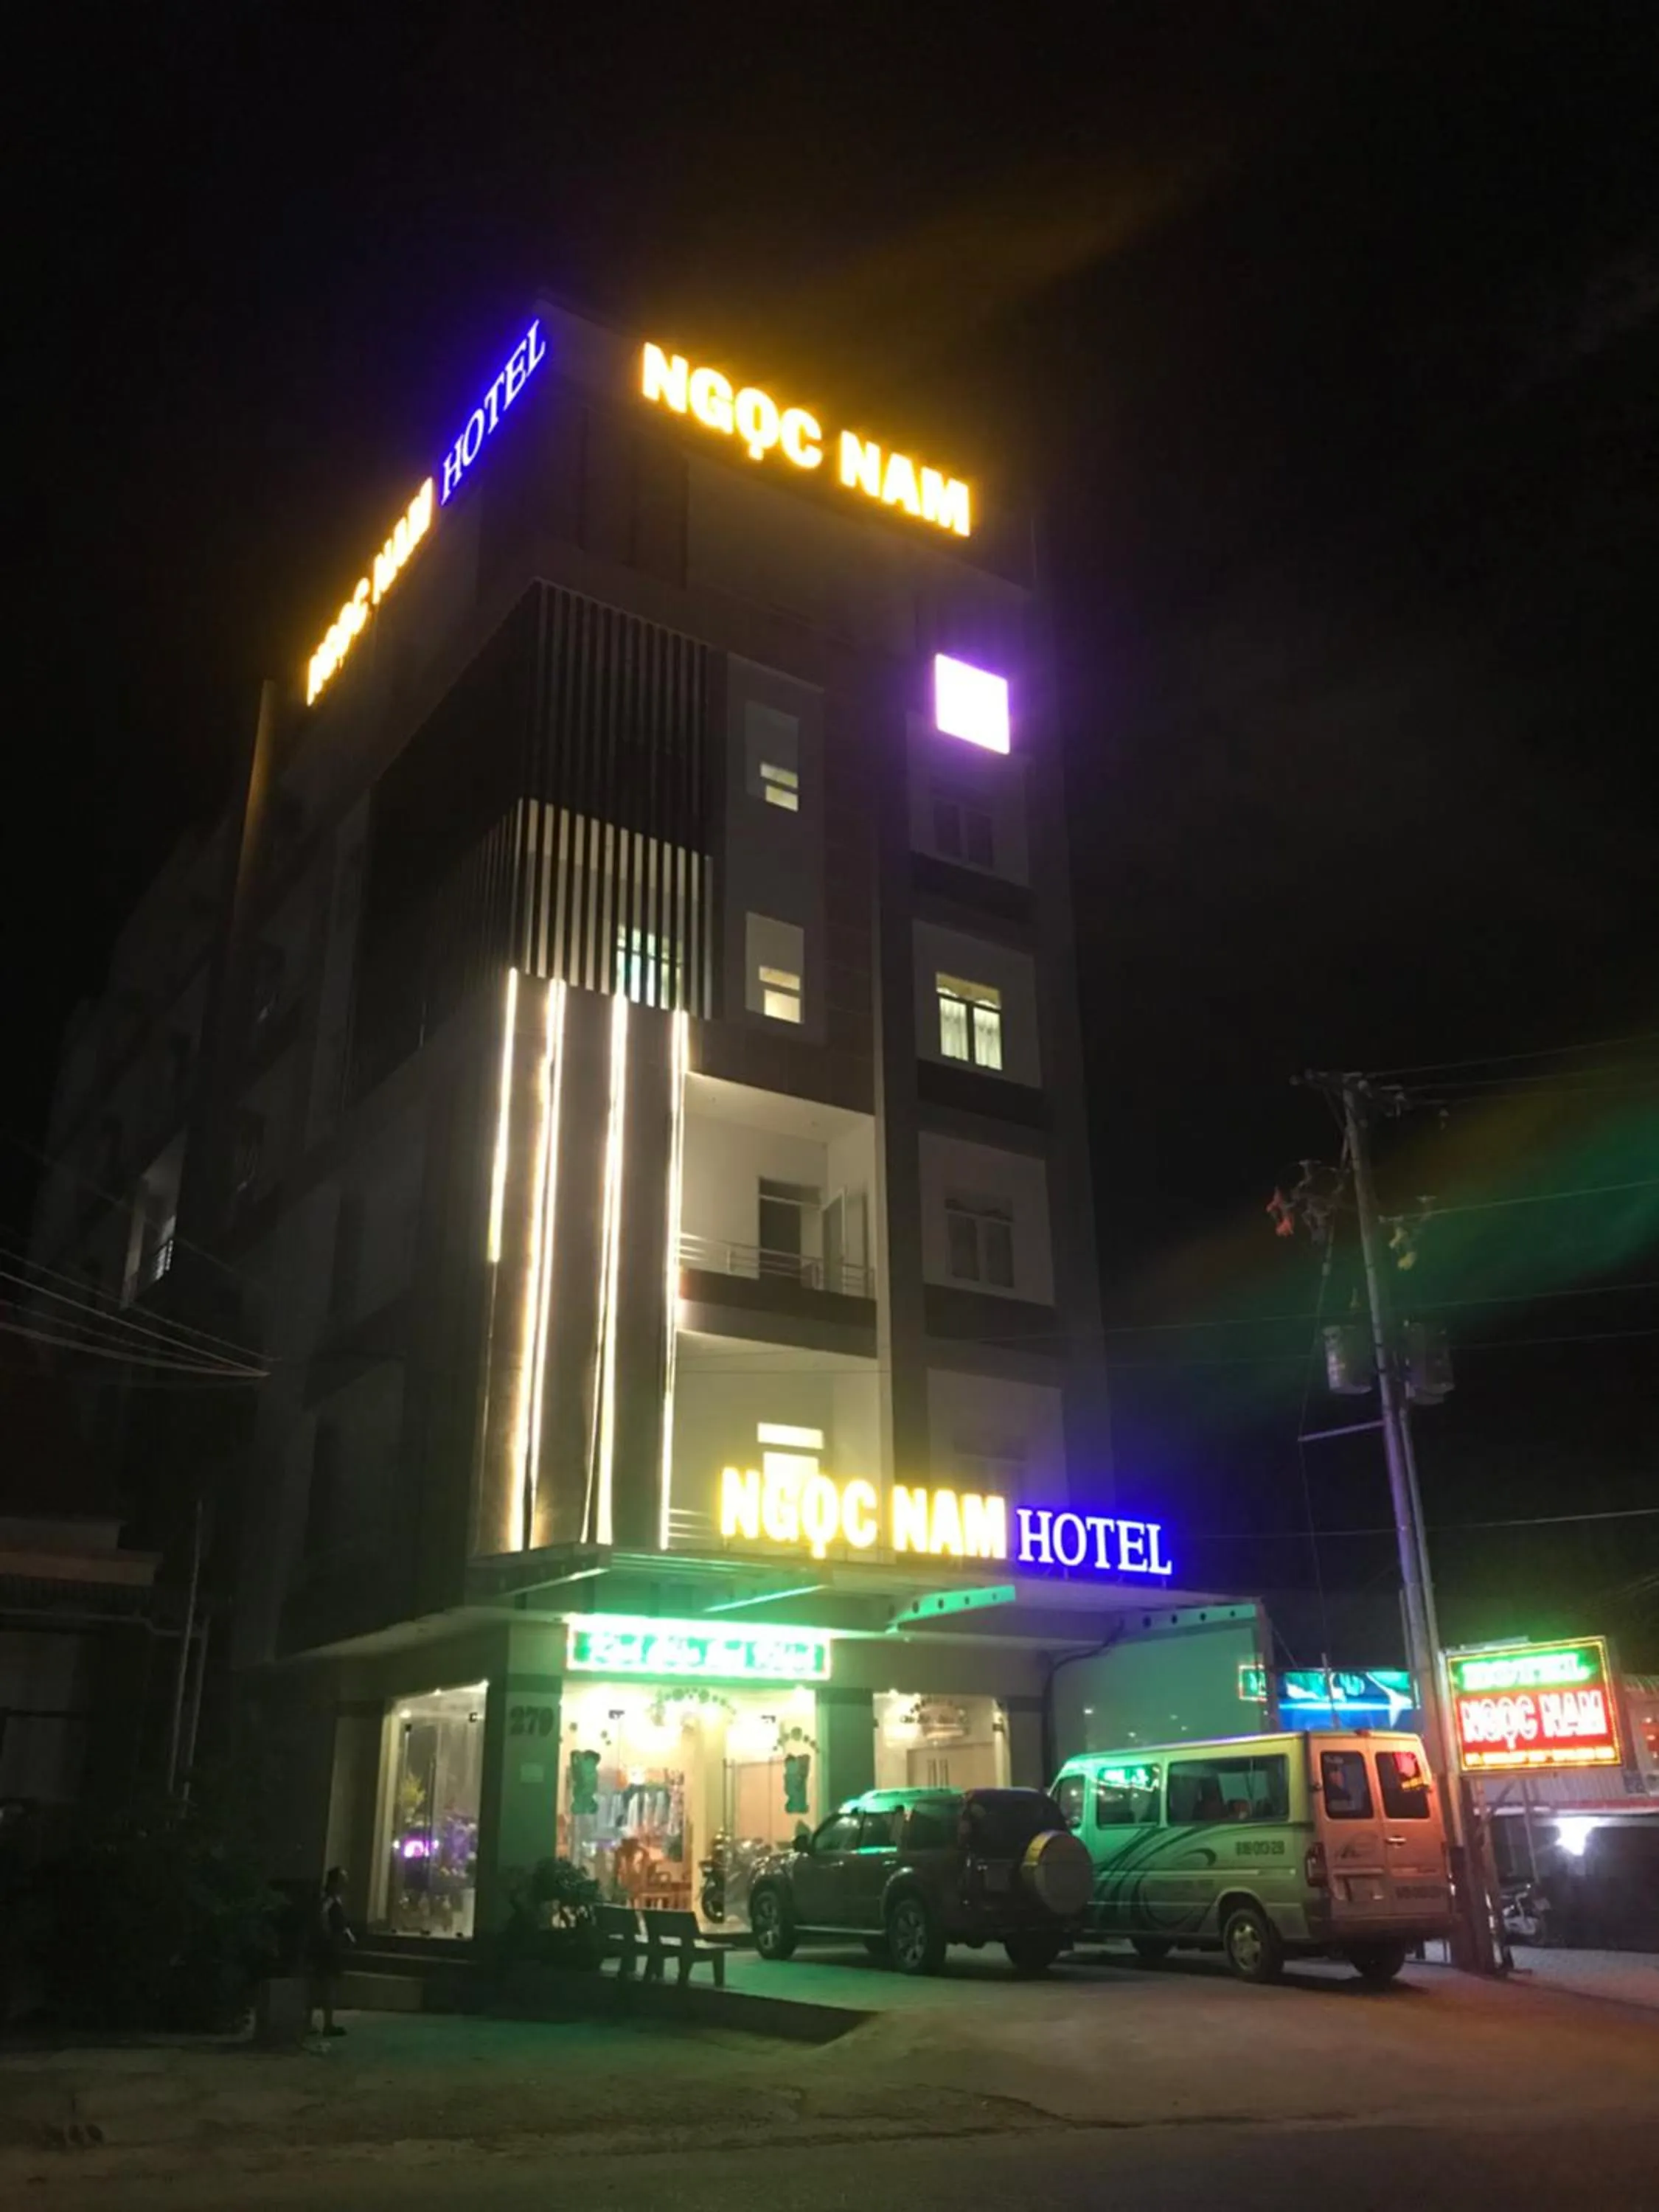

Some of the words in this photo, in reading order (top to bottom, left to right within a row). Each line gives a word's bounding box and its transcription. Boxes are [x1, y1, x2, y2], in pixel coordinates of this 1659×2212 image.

[440, 320, 545, 505] HOTEL
[642, 341, 824, 469] NGỌC
[839, 431, 972, 537] NAM
[720, 1467, 879, 1559] NGỌC
[891, 1484, 1006, 1559] NAM
[1017, 1509, 1172, 1575] HOTEL
[1539, 1690, 1607, 1738] NAM
